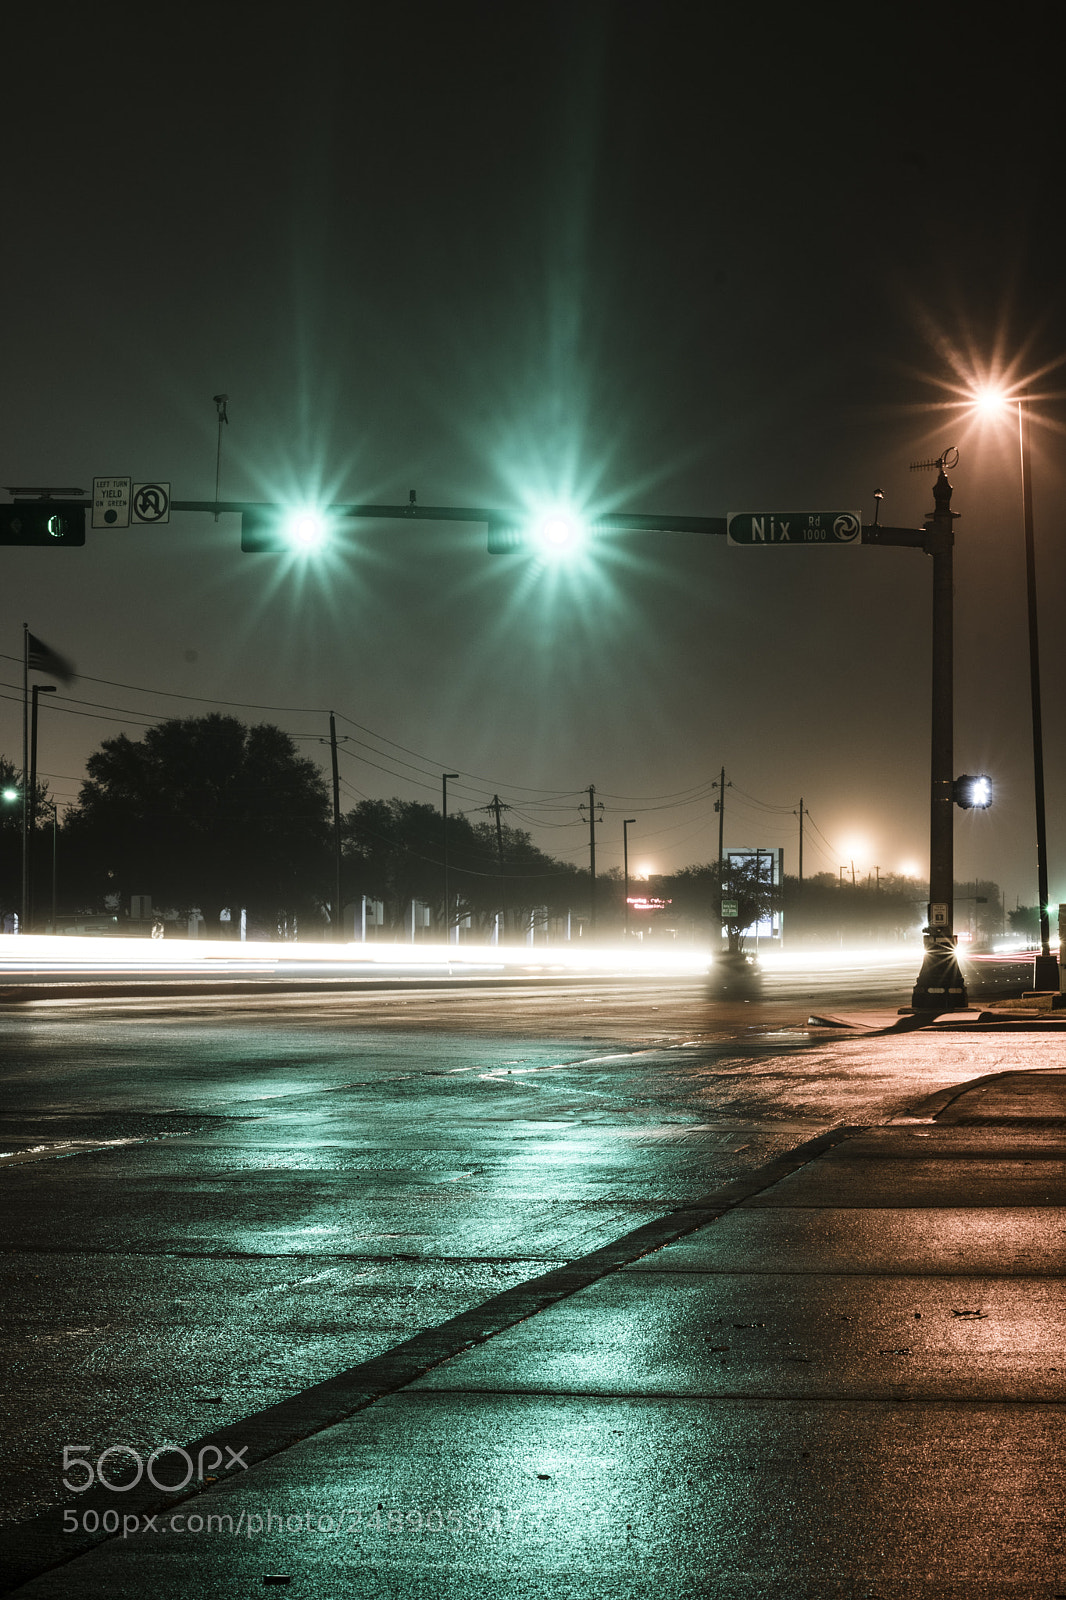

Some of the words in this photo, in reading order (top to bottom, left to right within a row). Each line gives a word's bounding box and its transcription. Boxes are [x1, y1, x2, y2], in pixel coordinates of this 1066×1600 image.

[102, 490, 122, 498] YIELD
[808, 516, 821, 527] Rd
[751, 516, 791, 541] Nix
[803, 529, 827, 540] 1000
